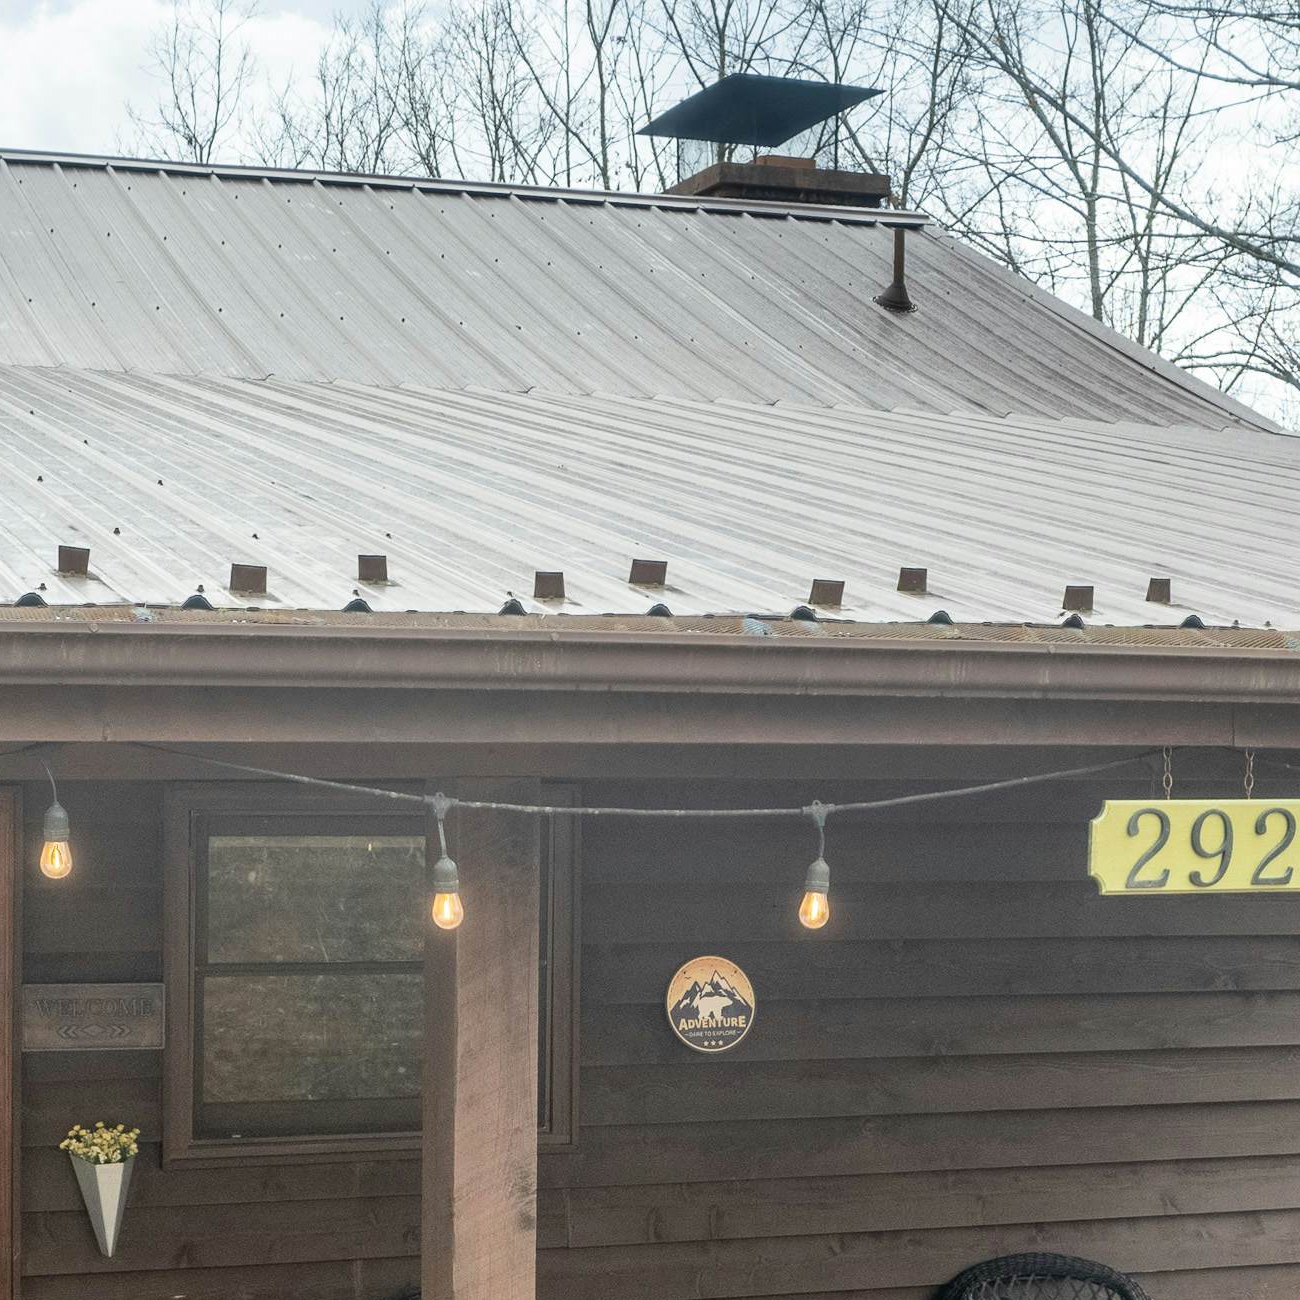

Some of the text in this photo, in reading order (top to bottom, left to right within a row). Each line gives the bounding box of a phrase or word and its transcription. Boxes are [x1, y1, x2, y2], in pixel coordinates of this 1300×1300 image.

[1125, 808, 1297, 888] 292
[33, 998, 154, 1017] WELCOME
[678, 1015, 747, 1031] ADVENTURE
